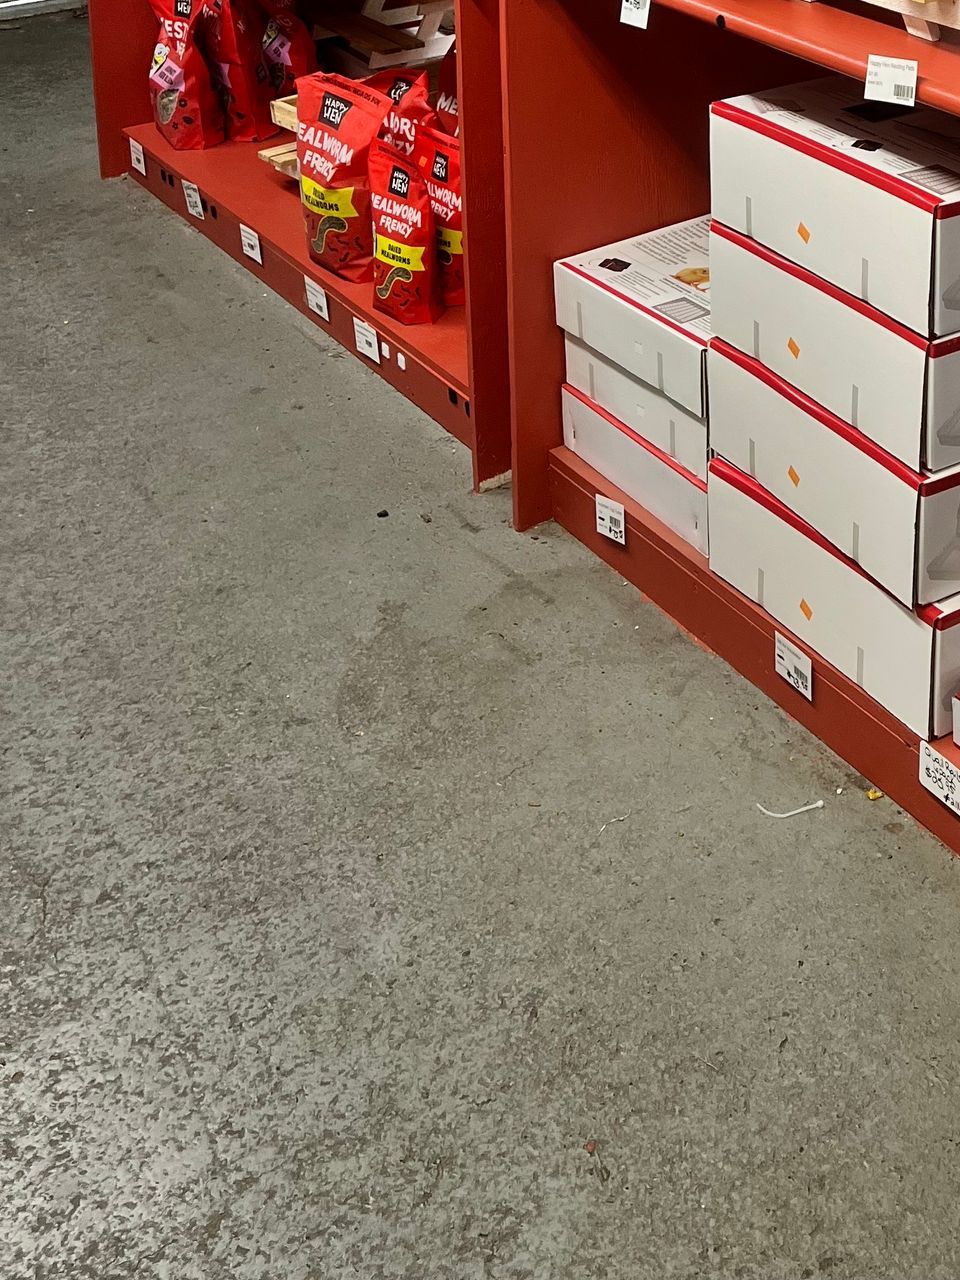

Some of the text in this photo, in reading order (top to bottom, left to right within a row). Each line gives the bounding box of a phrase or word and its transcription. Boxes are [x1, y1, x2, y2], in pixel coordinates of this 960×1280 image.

[325, 97, 349, 114] HAPPY
[323, 107, 342, 124] HEN
[303, 149, 337, 182] FRENZY
[393, 170, 409, 182] HAPPY
[391, 178, 408, 194] HEN
[380, 215, 414, 238] FRENZY
[381, 249, 411, 265] MEALWORMS
[388, 244, 401, 254] DRIED
